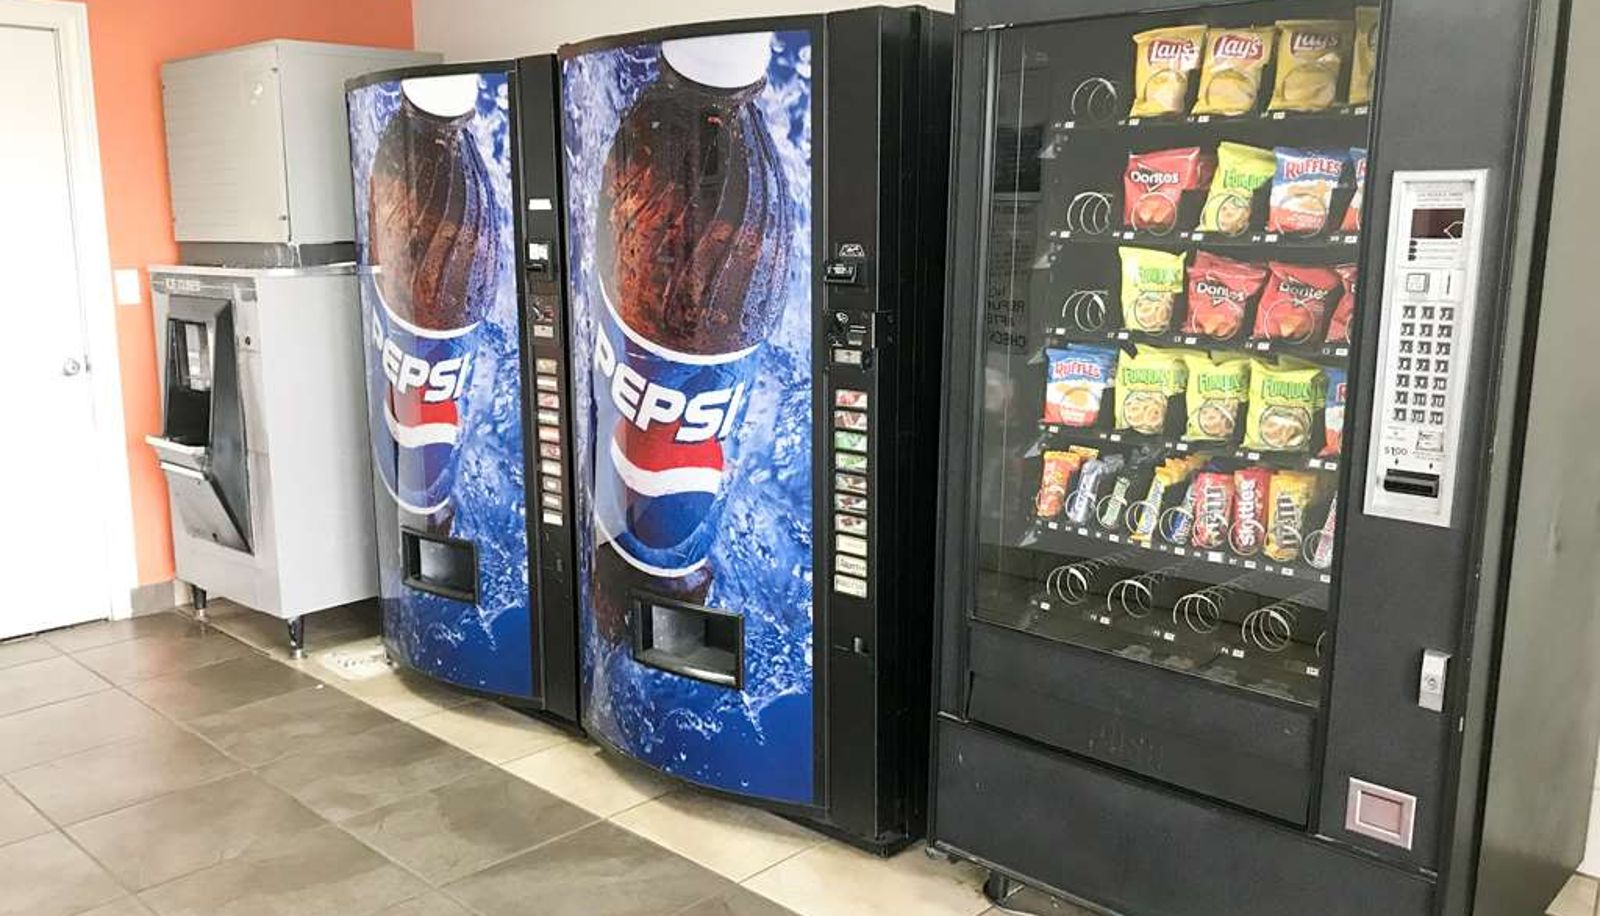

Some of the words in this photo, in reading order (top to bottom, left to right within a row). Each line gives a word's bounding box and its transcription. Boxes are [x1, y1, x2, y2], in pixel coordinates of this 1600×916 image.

[1151, 40, 1195, 63] Lay's
[1213, 35, 1262, 60] Lay's
[1131, 170, 1179, 185] Doritos
[1285, 158, 1341, 179] RUFFLES
[1196, 281, 1245, 302] Doritos
[371, 305, 471, 401] PEPSI
[1054, 361, 1102, 380] RUFFLES
[593, 323, 745, 442] PEPSI
